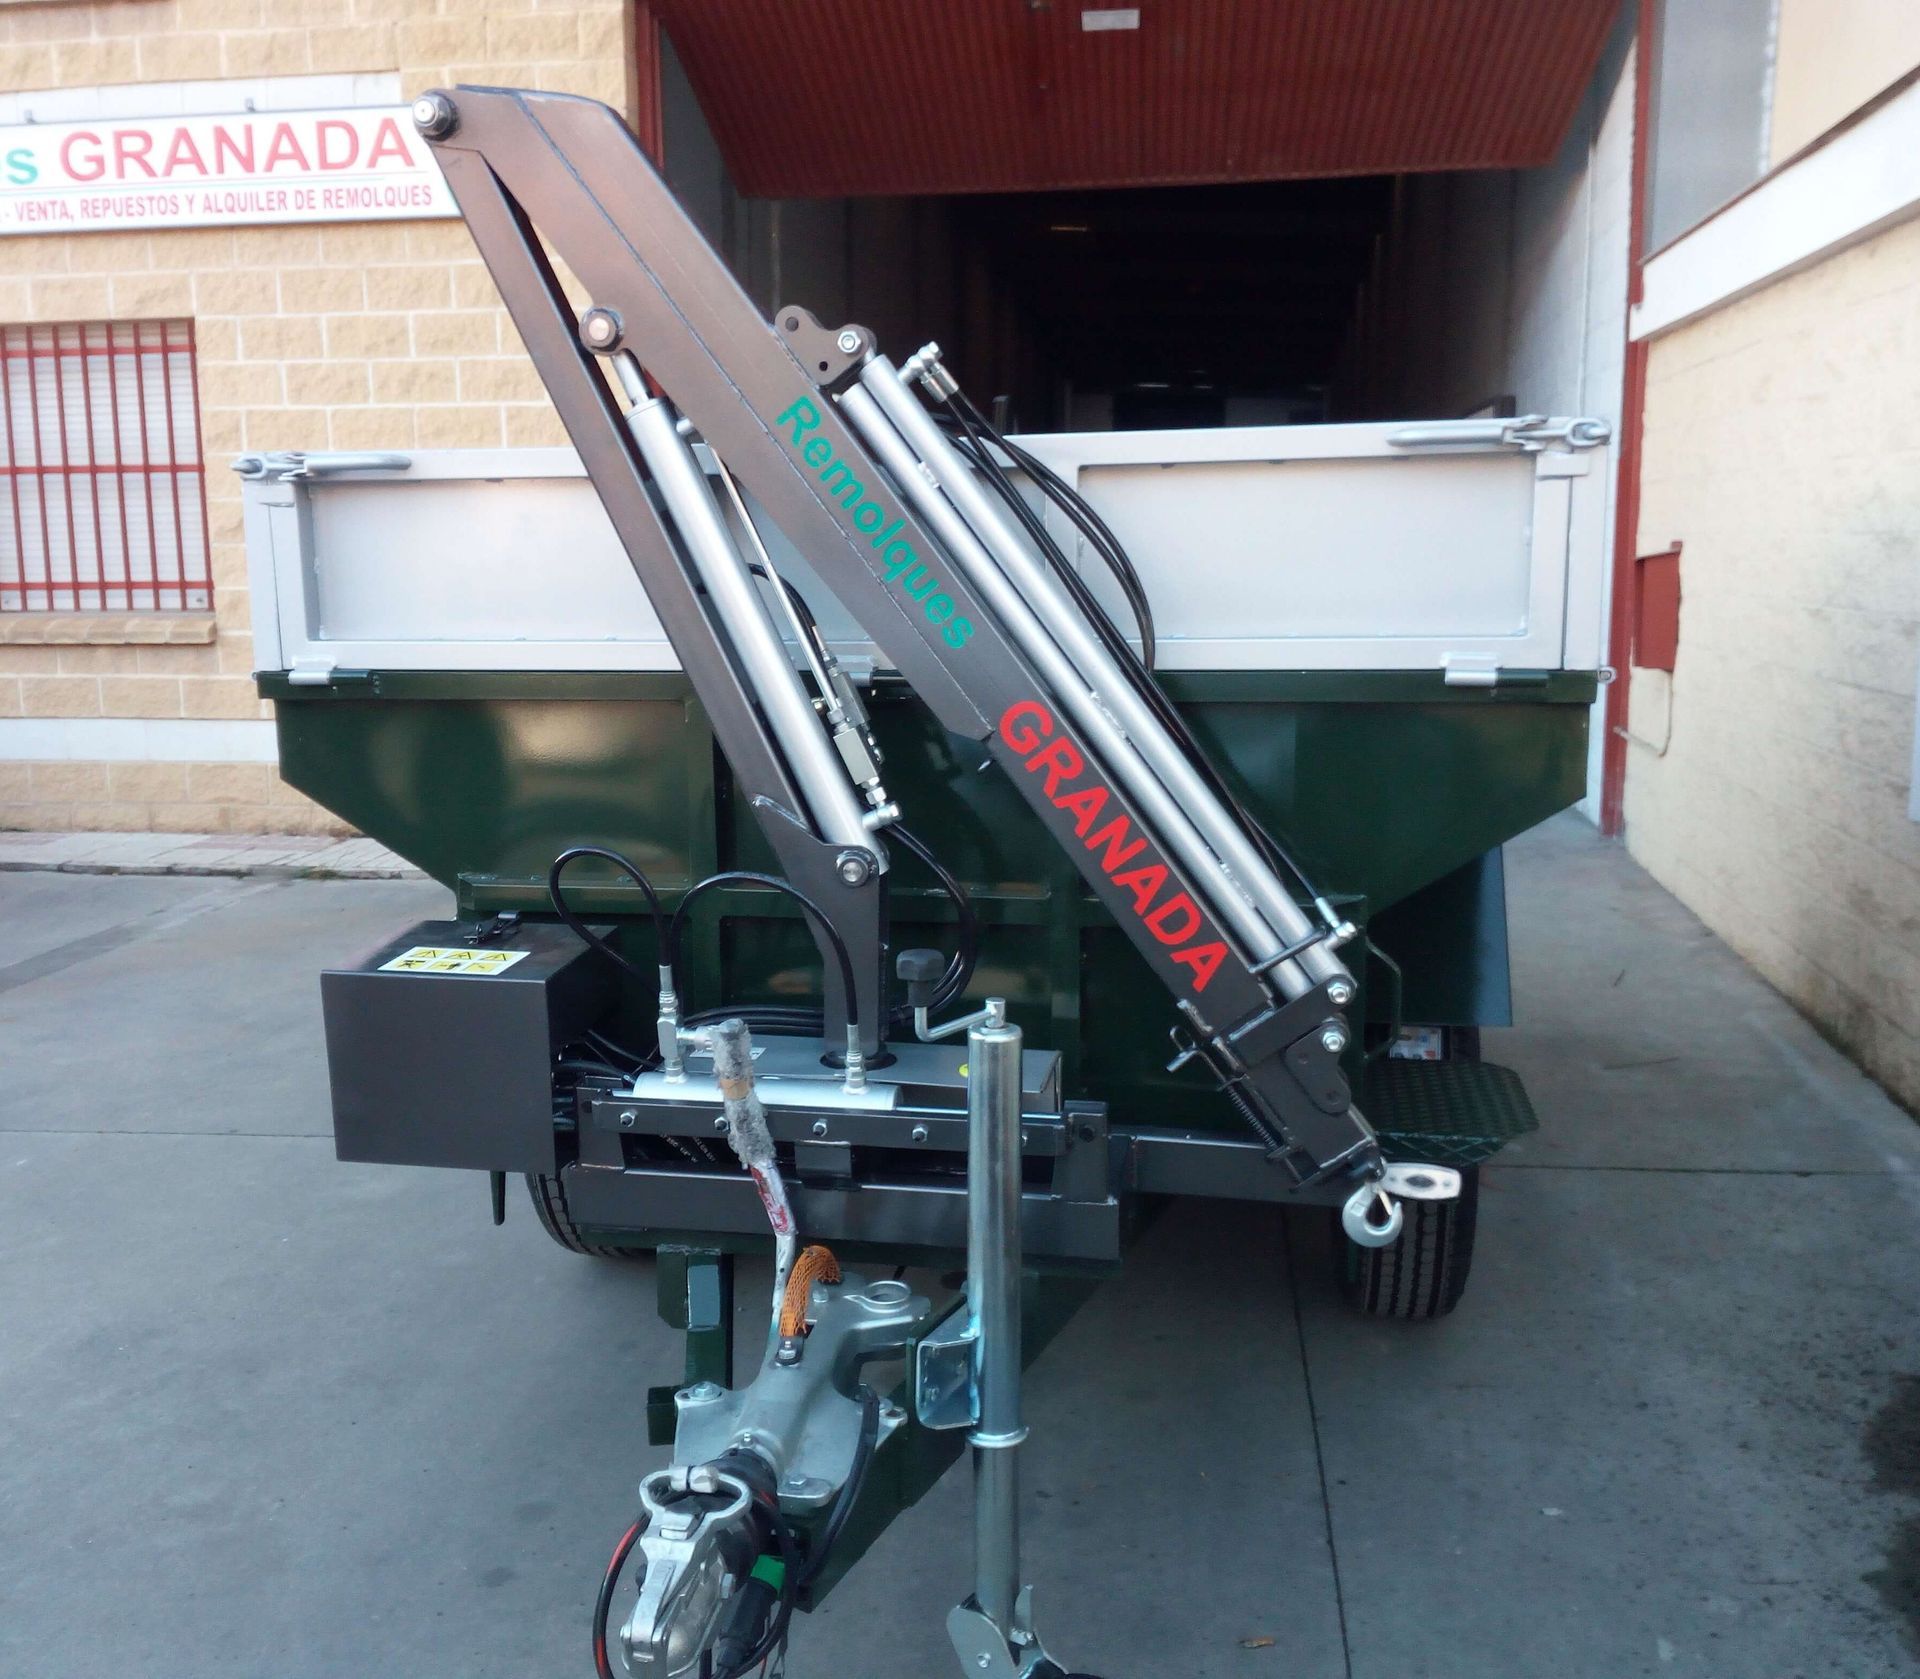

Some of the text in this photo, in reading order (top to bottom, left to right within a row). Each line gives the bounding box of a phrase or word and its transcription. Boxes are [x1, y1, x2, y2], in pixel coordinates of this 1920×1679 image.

[60, 117, 416, 182] GRANADA
[15, 200, 75, 222] VENTA,
[80, 195, 180, 219] REPUESTOS
[185, 193, 195, 214] Y
[203, 190, 288, 214] ALQUILER
[294, 189, 316, 210] DE
[323, 185, 432, 209] REMOLQUES
[776, 396, 1229, 991] Remolques GRANADA
